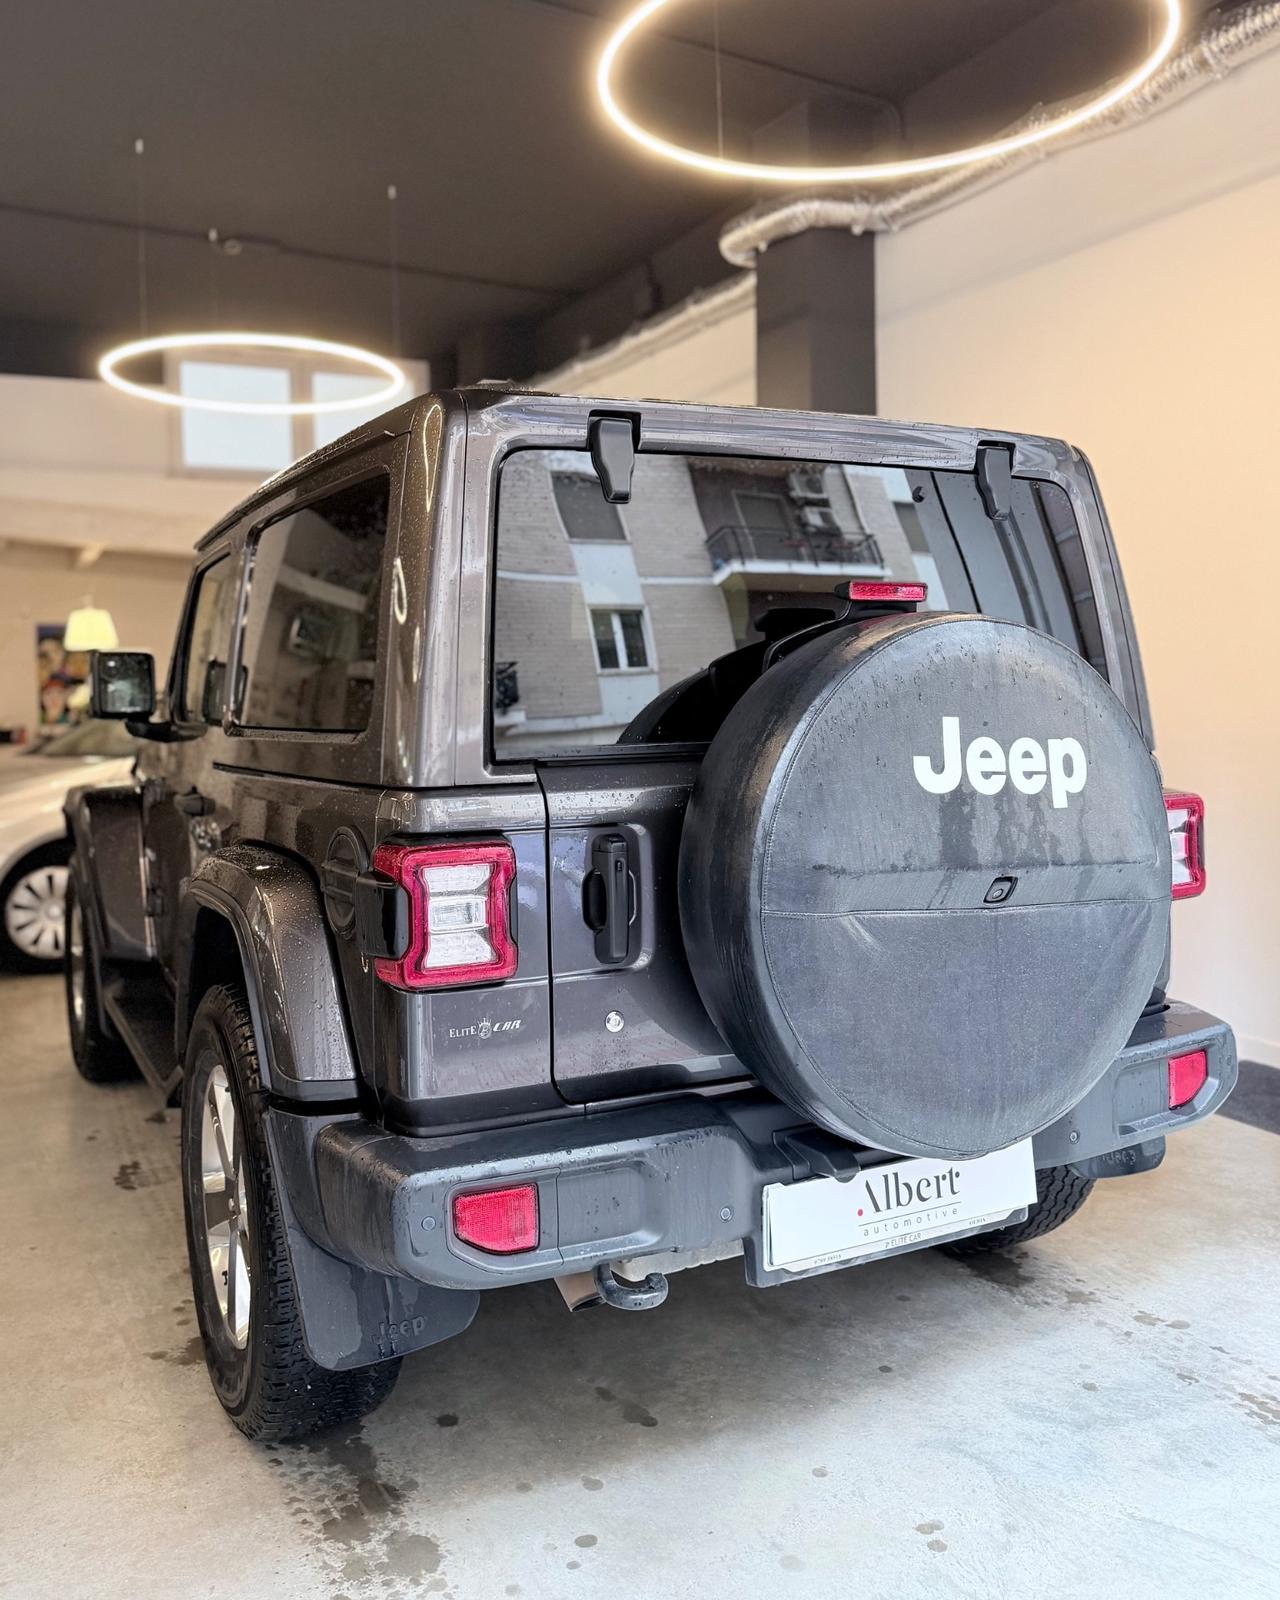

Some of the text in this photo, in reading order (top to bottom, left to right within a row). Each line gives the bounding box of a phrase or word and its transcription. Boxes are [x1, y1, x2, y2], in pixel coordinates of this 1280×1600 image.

[913, 716, 1087, 809] Jeep
[449, 1025, 477, 1038] ELITE
[493, 1019, 521, 1032] CAR
[864, 1167, 961, 1213] Albert
[863, 1207, 958, 1237] automotive
[891, 1232, 922, 1247] ELITE CAR
[370, 1315, 427, 1346] Jeep
